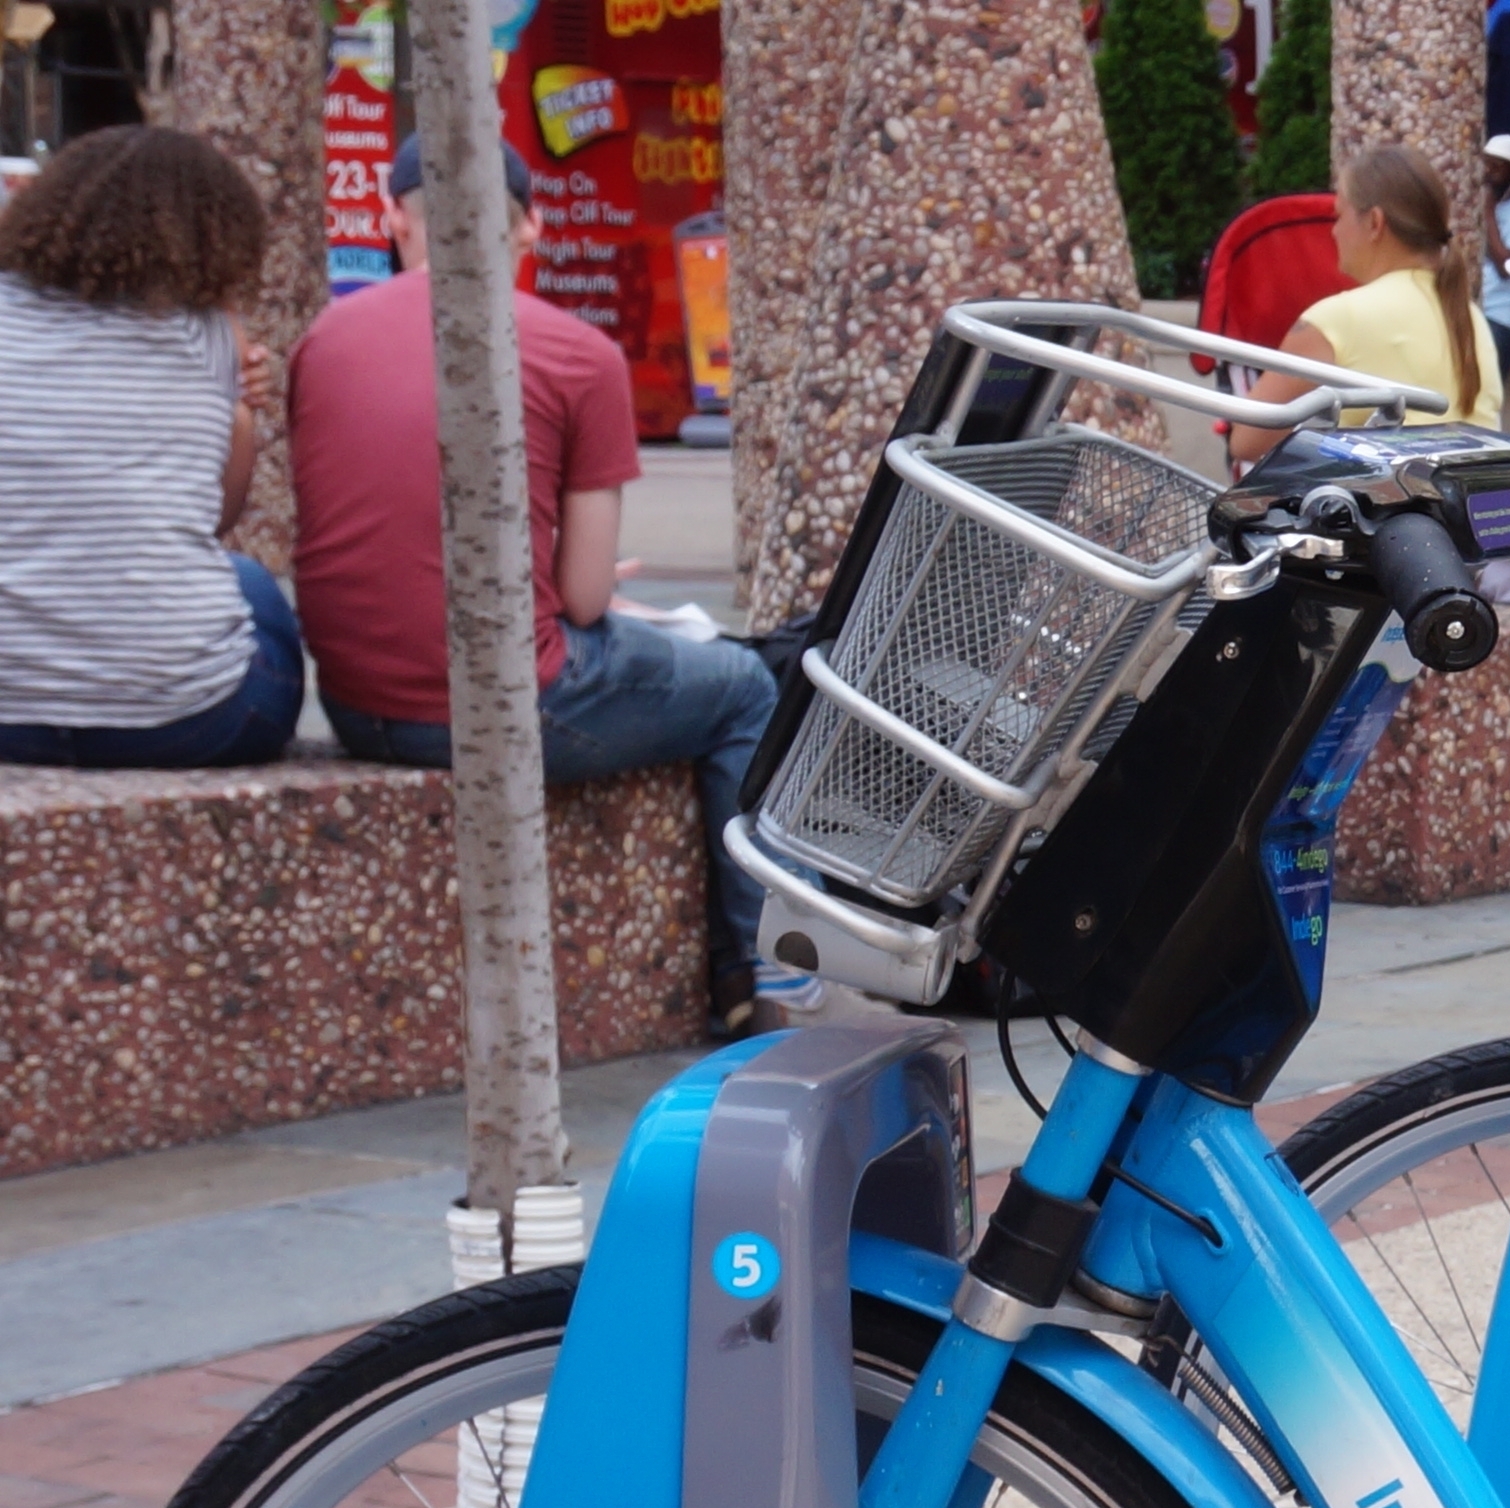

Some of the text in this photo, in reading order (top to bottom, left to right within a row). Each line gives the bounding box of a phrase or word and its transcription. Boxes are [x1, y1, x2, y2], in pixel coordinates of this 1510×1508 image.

[346, 95, 386, 121] Tour
[540, 78, 614, 118] TICKET
[567, 106, 614, 139] INFO
[569, 170, 597, 196] On
[600, 202, 635, 226] Tour
[581, 236, 616, 260] Tour
[536, 267, 618, 292] Museums
[732, 1244, 761, 1288] 5
